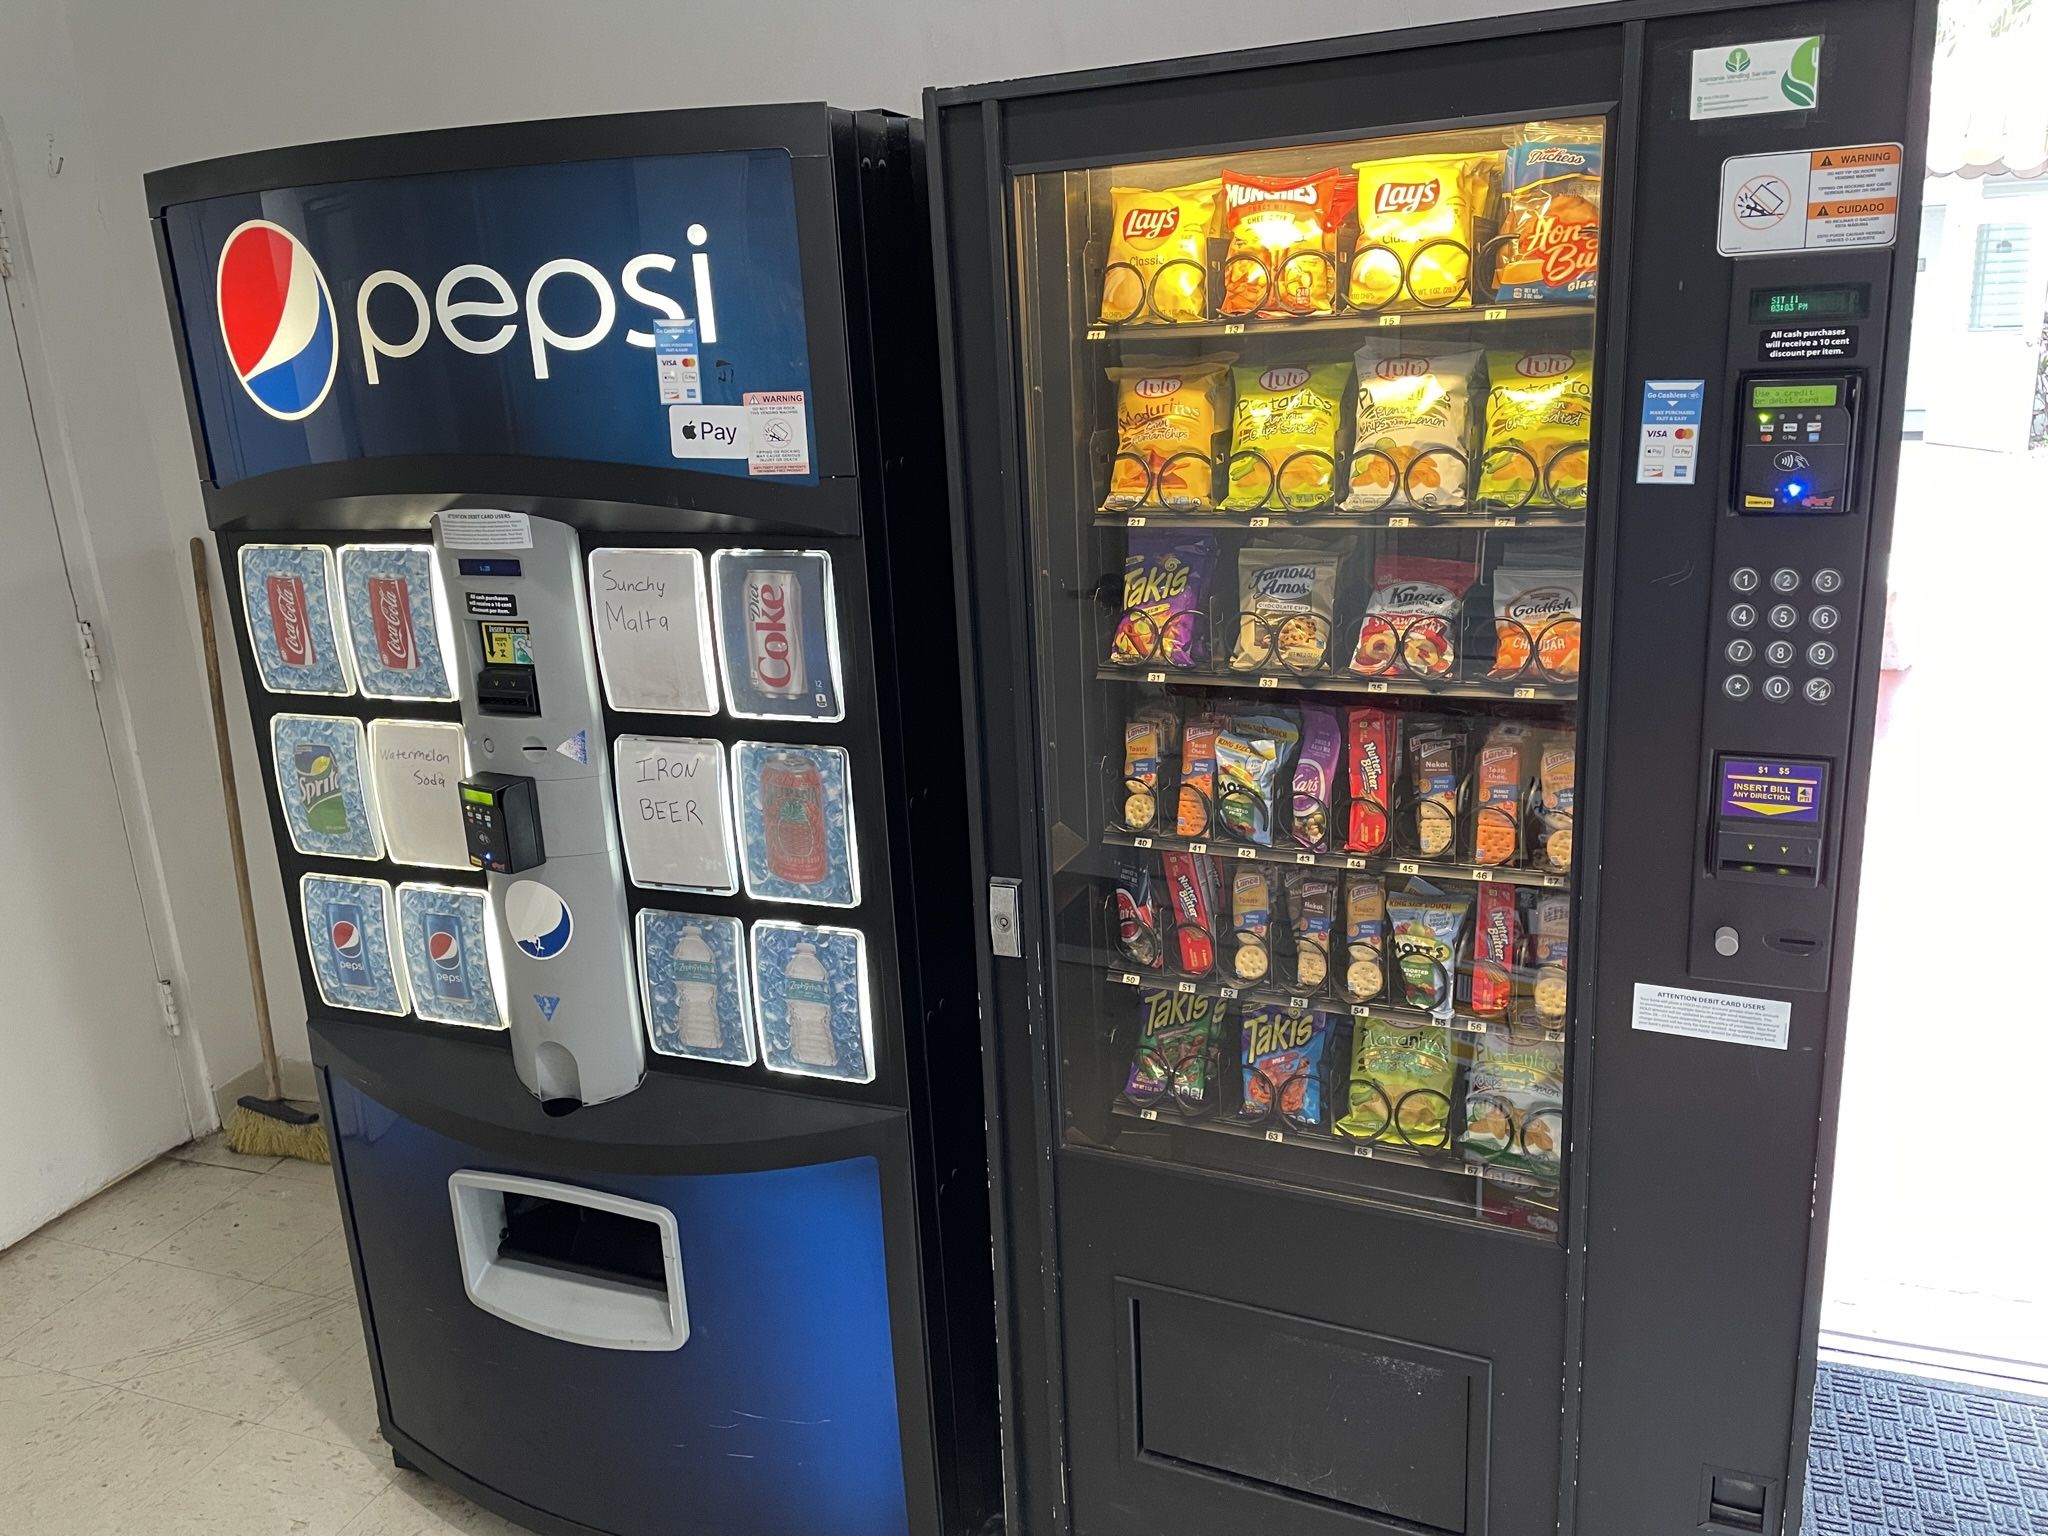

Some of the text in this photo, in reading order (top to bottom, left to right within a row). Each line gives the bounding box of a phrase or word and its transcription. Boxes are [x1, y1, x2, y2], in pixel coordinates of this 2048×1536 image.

[1527, 148, 1584, 165] Duchess
[1841, 152, 1891, 163] WARNING
[1376, 180, 1437, 213] Lay's
[1837, 203, 1885, 214] CUIDADO
[1125, 207, 1178, 240] Lay's
[357, 222, 717, 385] pepsi
[1770, 302, 1809, 313] 03:03 PM
[1489, 310, 1500, 319] 17
[1383, 317, 1395, 326] 15
[1090, 331, 1101, 340] 11
[1228, 325, 1240, 334] 13
[1770, 328, 1846, 339] All cash purchases
[1765, 340, 1781, 349] will
[1781, 339, 1811, 349] receive
[1820, 338, 1829, 346] 10
[1831, 337, 1850, 345] cent
[1769, 348, 1844, 358] discount per item.
[762, 394, 803, 403] WARNING
[1658, 391, 1687, 399] Cashless
[1784, 388, 1817, 397] credit
[1768, 397, 1794, 405] debit
[1799, 396, 1819, 404] card
[1119, 397, 1200, 432] Maduritos
[701, 421, 737, 445] Pay
[1646, 430, 1668, 438] VISA
[1252, 519, 1264, 527] 23
[1392, 519, 1404, 527] 25
[601, 569, 665, 598] Sunchy
[1247, 566, 1317, 590] Famous
[1742, 574, 1749, 586] 1
[1783, 574, 1791, 587] 2
[1824, 575, 1832, 588] 3
[1124, 558, 1190, 611] Takis
[1253, 578, 1307, 600] Amos
[1388, 585, 1446, 605] Knott's
[750, 583, 760, 623] Diet
[1258, 602, 1294, 610] CHOCOLATE
[1513, 596, 1572, 618] Goldfish
[605, 601, 669, 633] Malta
[1738, 610, 1747, 622] 4
[1780, 611, 1788, 623] 5
[1820, 612, 1829, 624] 6
[755, 583, 792, 688] Coke
[1736, 645, 1745, 657] 7
[1776, 647, 1785, 659] 8
[1817, 648, 1826, 660] 9
[1150, 674, 1161, 682] 31
[1262, 679, 1273, 687] 33
[1517, 689, 1529, 697] 37
[1774, 682, 1782, 694] 0
[1127, 726, 1149, 738] Lance
[1217, 737, 1233, 748] KING
[380, 749, 450, 764] Watermelon
[1363, 741, 1382, 775] Nutter
[635, 757, 699, 784] IRON
[1361, 758, 1378, 790] Butter
[1758, 766, 1790, 775] $1 $5
[413, 769, 446, 788] Soda
[1733, 783, 1791, 794] INSERT BILL
[1750, 792, 1791, 801] DIRECTION
[639, 798, 703, 825] BEER
[1137, 839, 1148, 847] 40
[1191, 844, 1202, 852] 41
[1350, 860, 1361, 868] 44
[1402, 865, 1414, 873] 45
[1475, 871, 1488, 880] 46
[1236, 876, 1260, 889] Lance
[1178, 875, 1198, 903] Nutter
[1179, 890, 1198, 918] Butter
[1425, 902, 1451, 910] POUCH
[1491, 911, 1509, 945] Nutter
[1487, 927, 1504, 960] Butter
[339, 958, 365, 973] pepsi
[435, 971, 463, 985] pepsi
[1125, 975, 1136, 984] 50
[1223, 989, 1234, 998] 52
[1293, 999, 1304, 1007] 53
[1657, 991, 1697, 1002] ATTENTION
[1698, 996, 1719, 1005] DEBIT
[1720, 999, 1742, 1008] CARD
[1742, 1003, 1766, 1011] USERS
[1145, 989, 1209, 1036] Takis
[1353, 1006, 1364, 1015] 54
[1434, 1018, 1446, 1026] 55
[1470, 1023, 1482, 1031] 56
[1244, 1012, 1314, 1064] Takis
[1142, 1111, 1152, 1119] 61
[1268, 1132, 1279, 1141] 63
[1357, 1148, 1368, 1156] 65
[1467, 1166, 1479, 1175] 67
